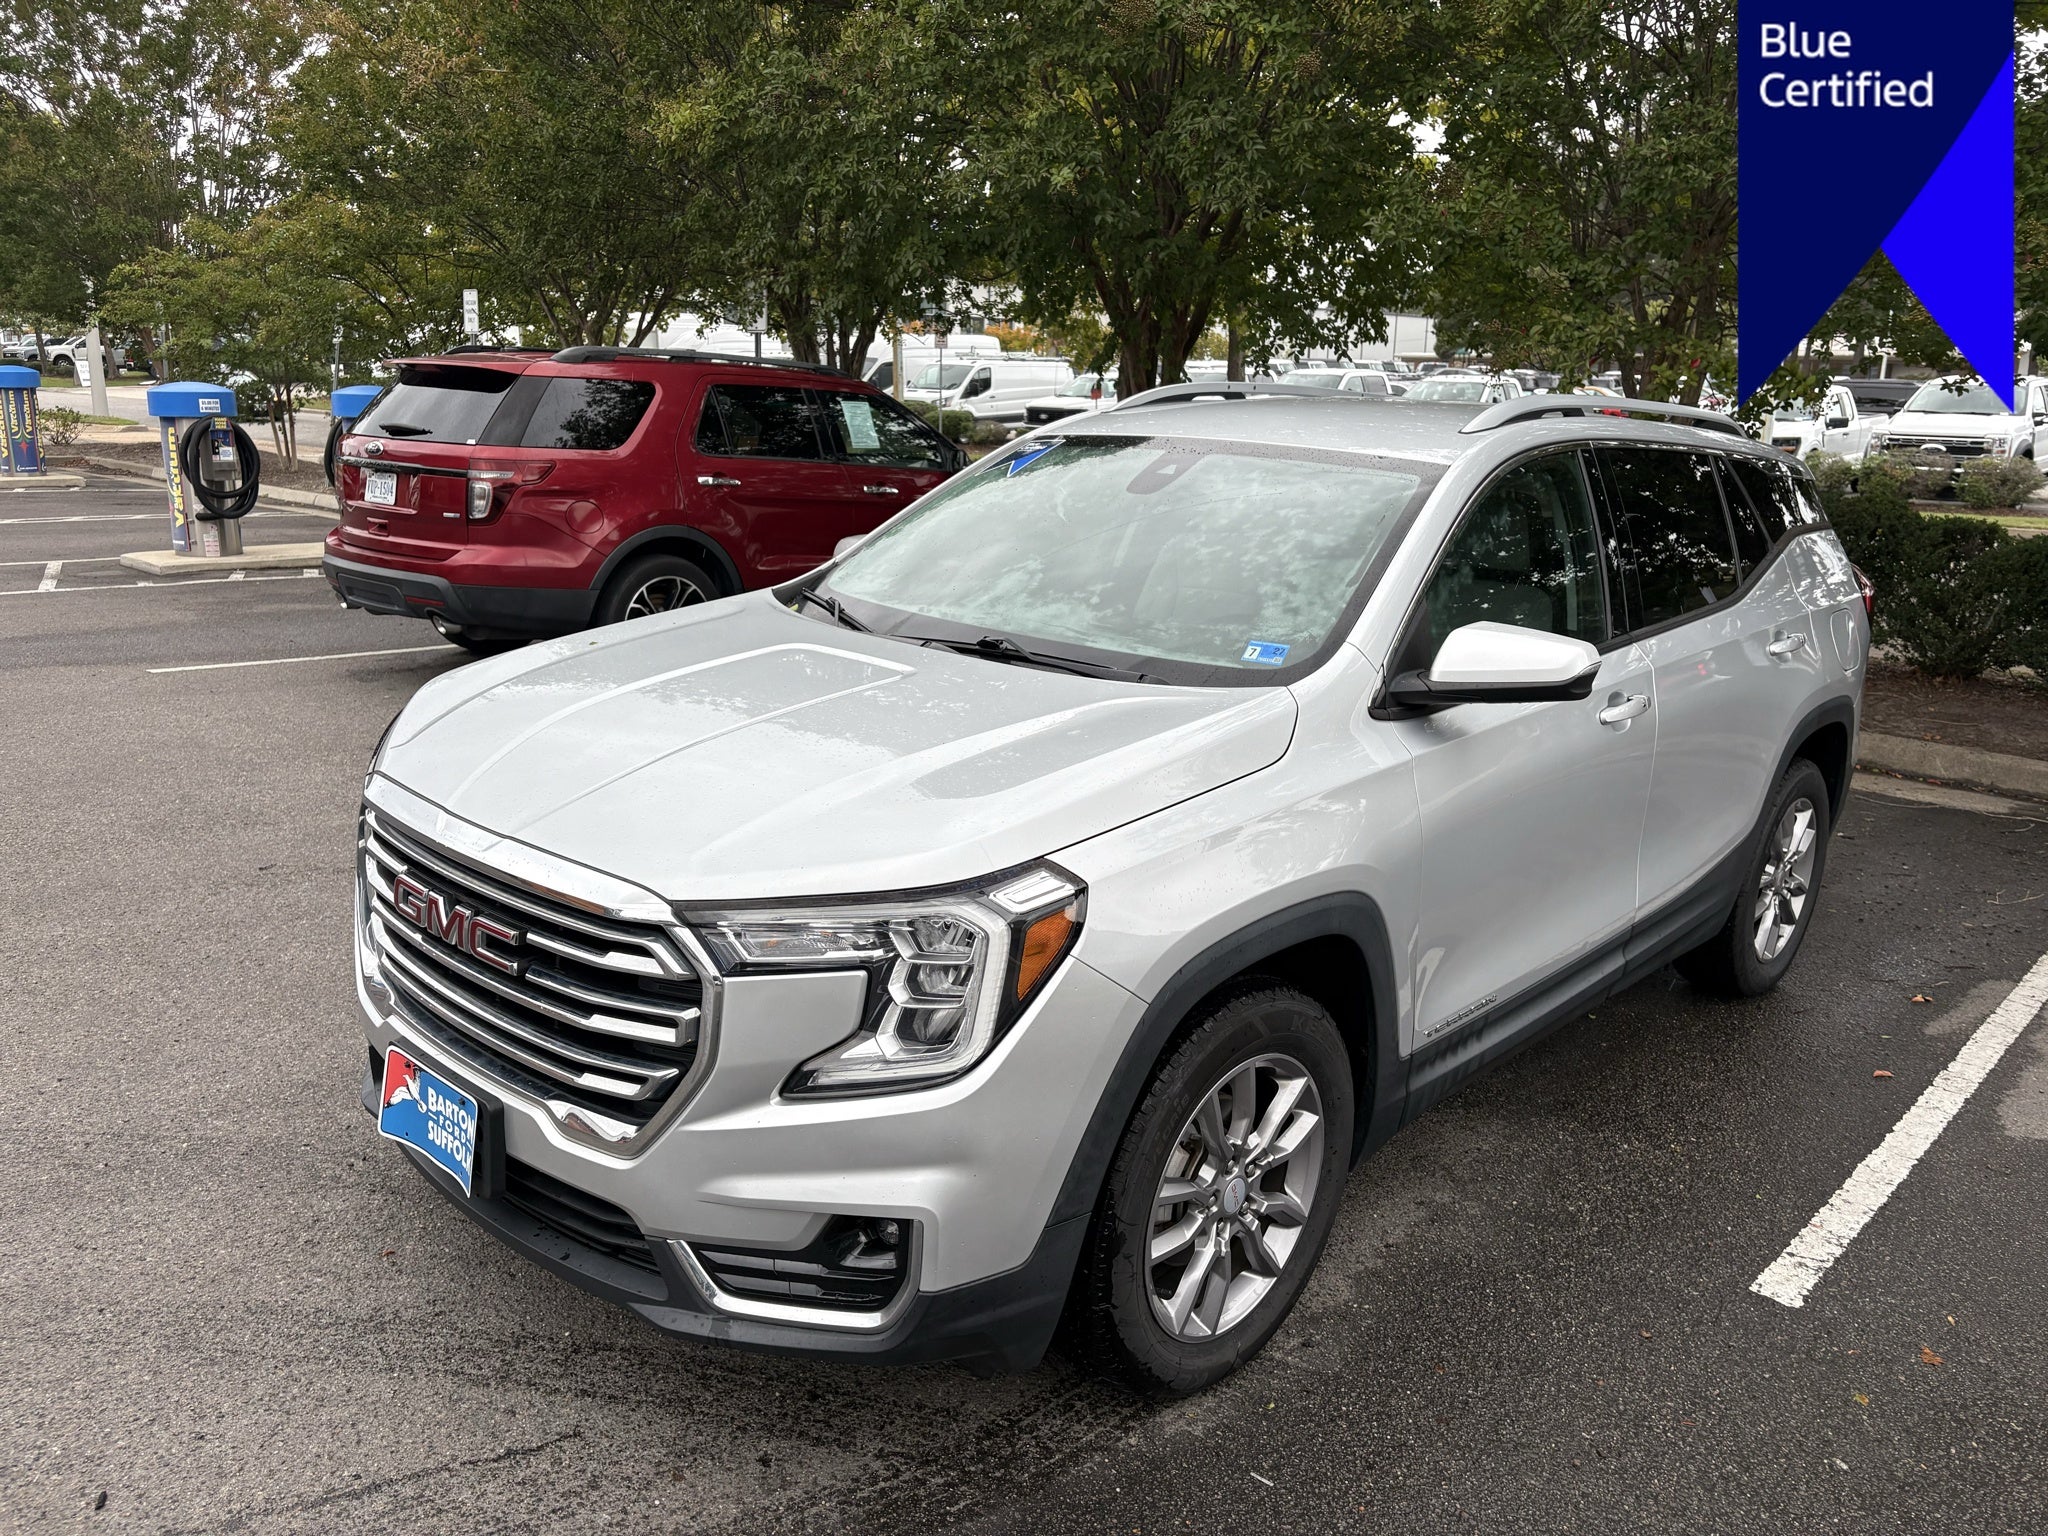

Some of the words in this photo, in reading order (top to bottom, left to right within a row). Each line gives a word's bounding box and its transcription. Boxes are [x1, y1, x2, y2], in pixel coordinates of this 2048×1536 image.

[1248, 647, 1257, 657] 7
[1272, 647, 1286, 656] 27
[394, 873, 528, 976] GMC
[427, 1086, 475, 1143] BARTON
[439, 1118, 466, 1144] FORD
[428, 1121, 473, 1174] SUFFOLK
